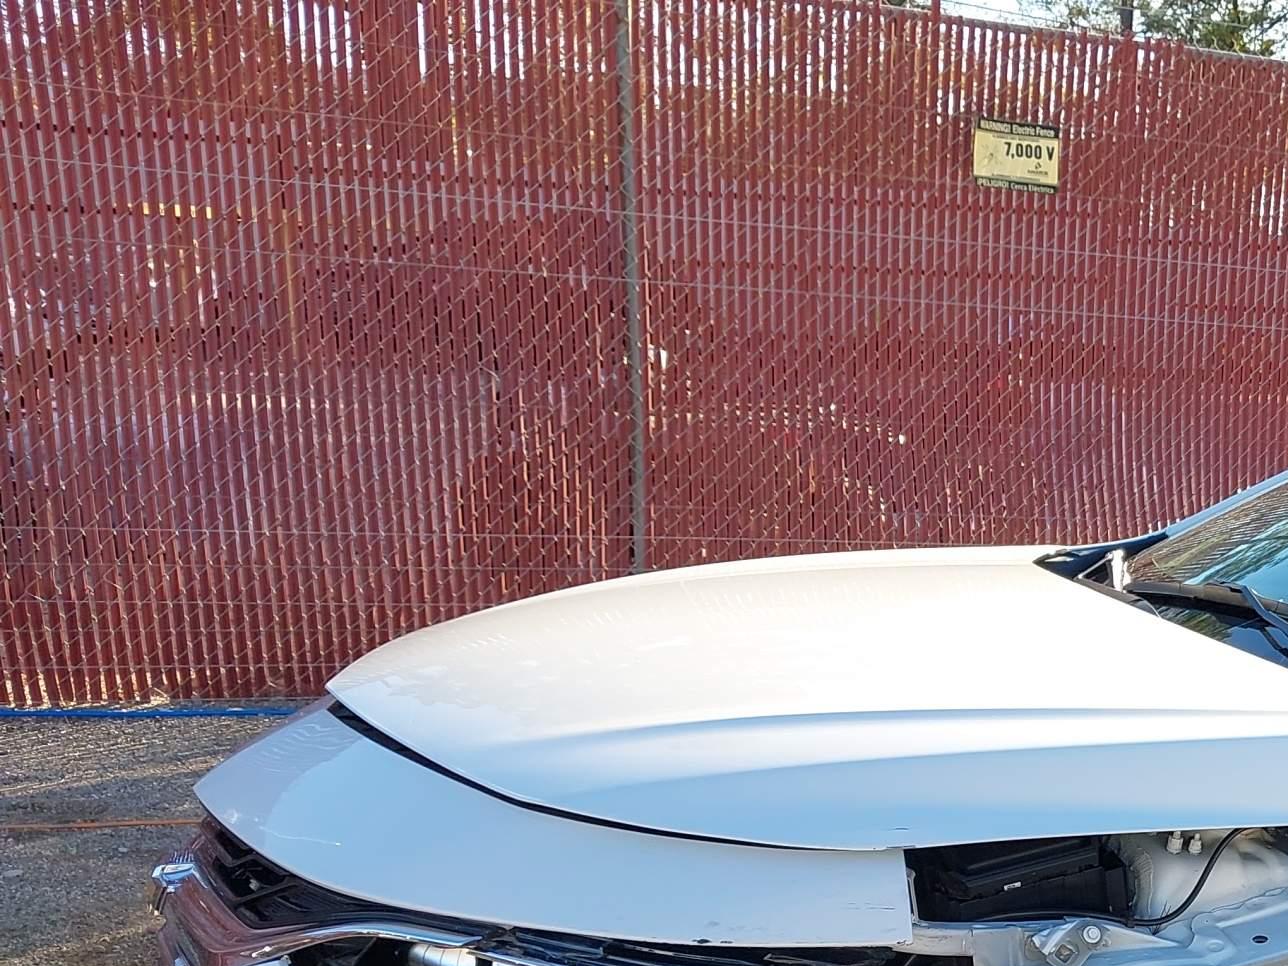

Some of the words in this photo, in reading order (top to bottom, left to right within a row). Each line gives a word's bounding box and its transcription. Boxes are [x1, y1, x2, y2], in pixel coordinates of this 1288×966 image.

[1012, 124, 1035, 136] Electric
[1036, 126, 1055, 137] Fence
[1004, 141, 1042, 160] 7,000
[1046, 146, 1055, 161] V
